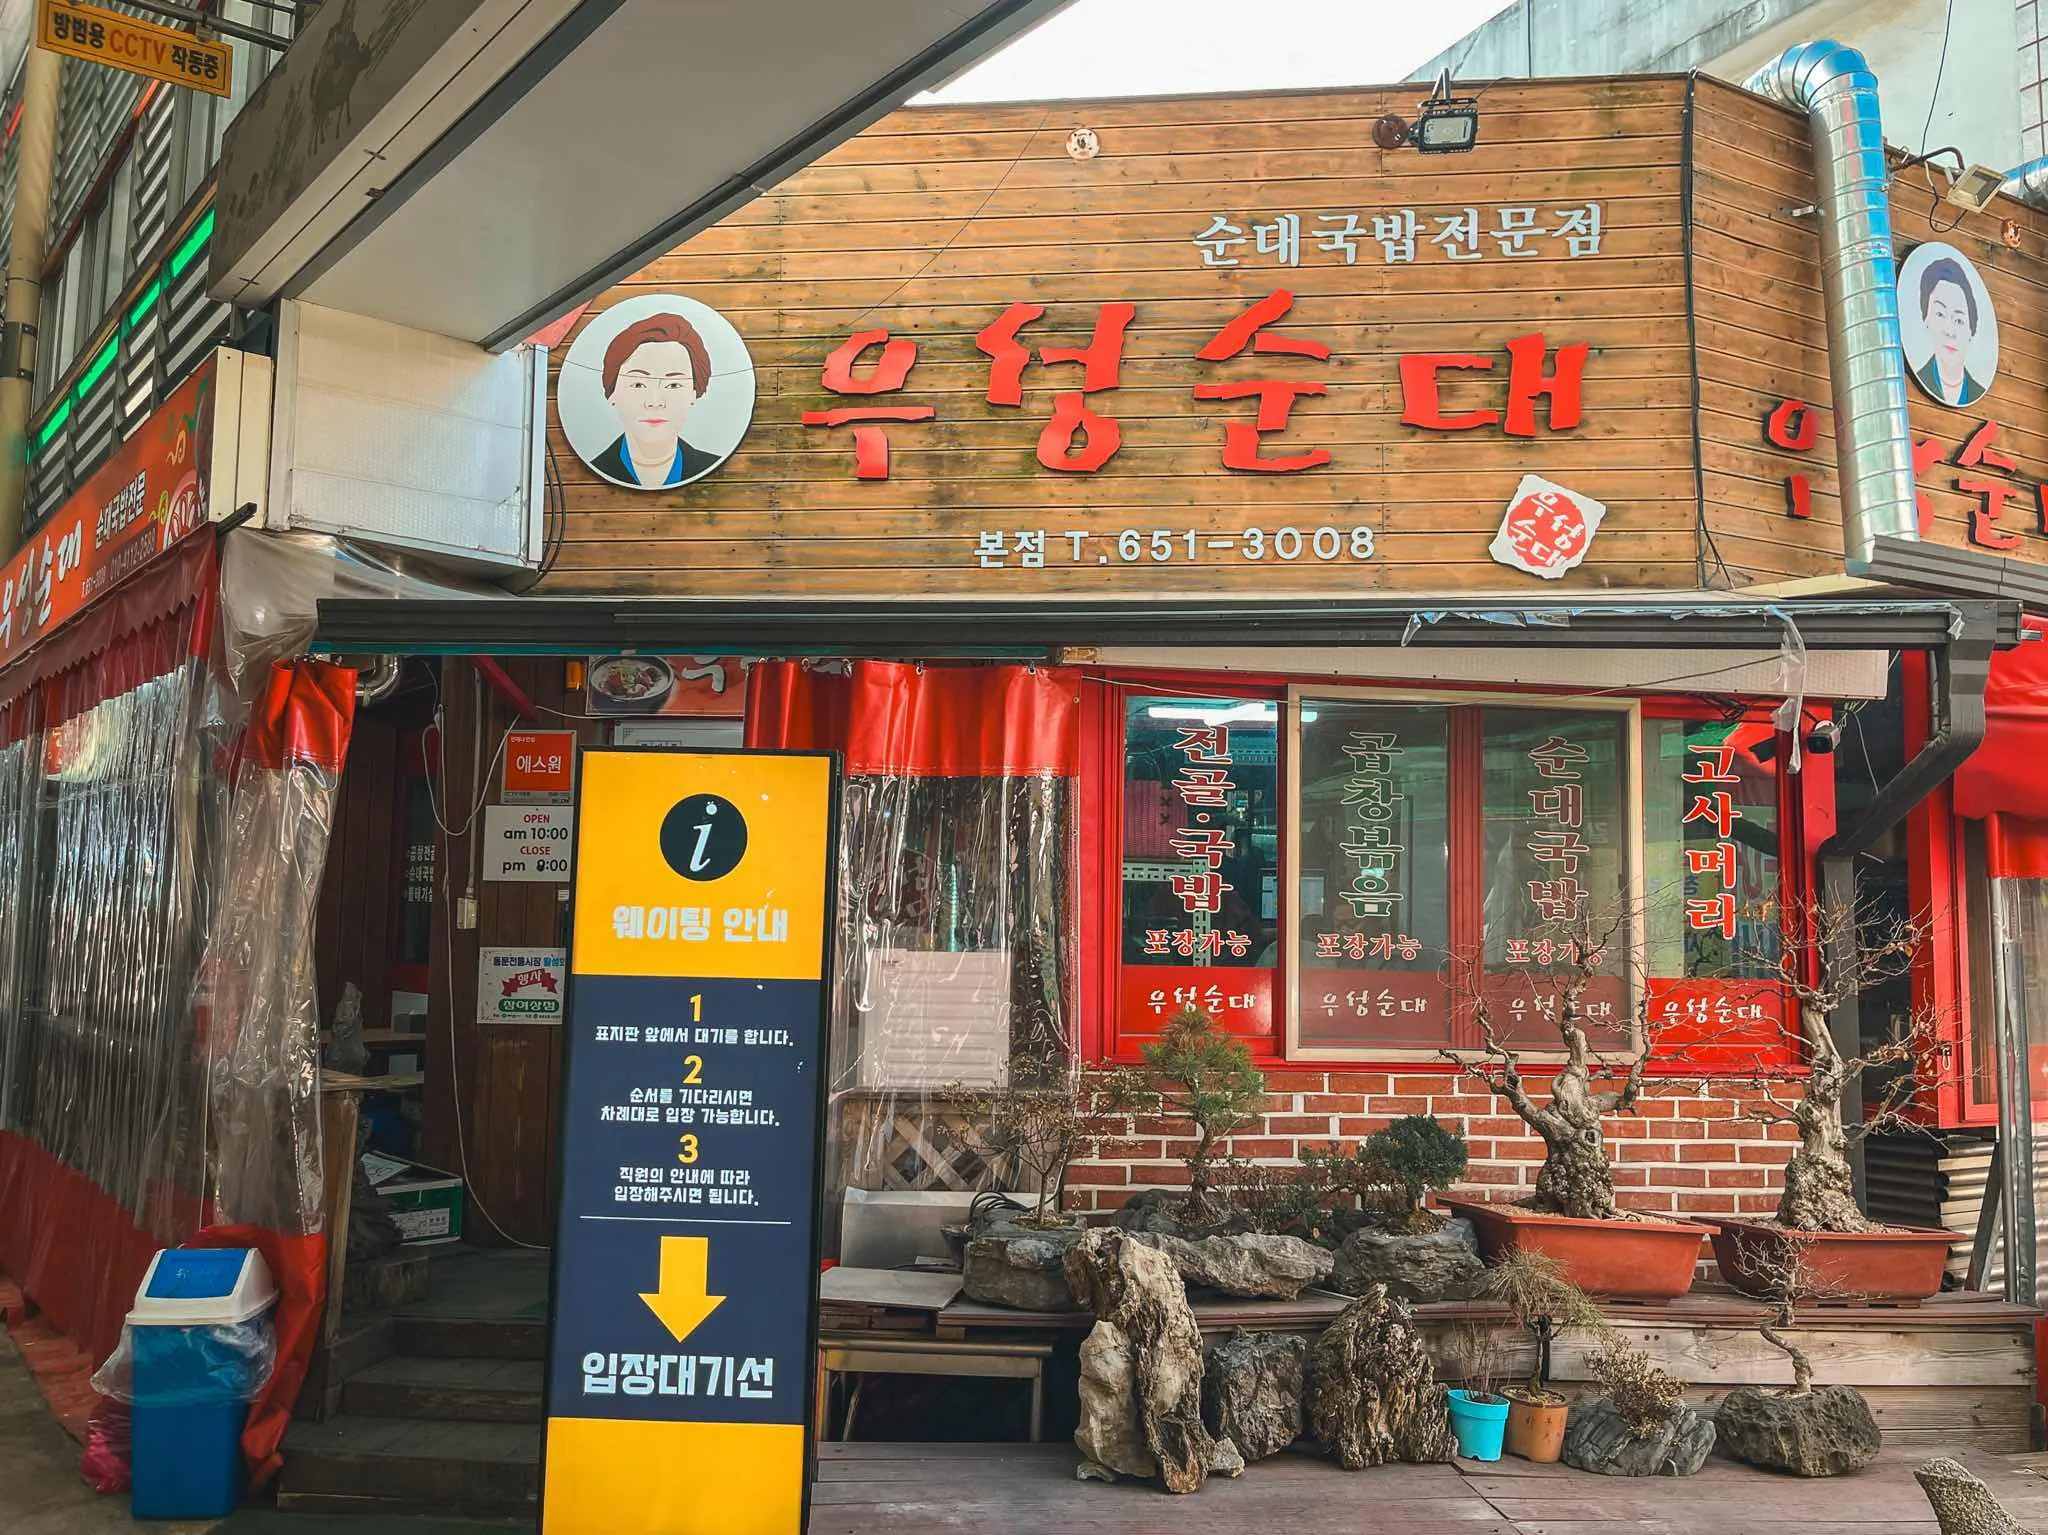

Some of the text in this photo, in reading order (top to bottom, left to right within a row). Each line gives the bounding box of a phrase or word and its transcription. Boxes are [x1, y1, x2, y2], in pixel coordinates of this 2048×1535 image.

[54, 12, 219, 80] 방범용 CCTV 작동중
[1193, 203, 1601, 267] 순대국밥전문점
[802, 289, 1590, 479] 우성순대
[1531, 492, 1585, 550] 우성
[974, 526, 1376, 568] 본점 T.651-3008
[1509, 519, 1570, 568] 순대
[516, 755, 562, 774] 에스원
[524, 814, 550, 823] OPEN
[1338, 730, 1405, 918] 곱창볶음
[1527, 736, 1590, 921] 순대국밥
[503, 828, 568, 840] am 10:00
[1681, 744, 1742, 940] 고사머리
[520, 846, 551, 855] CLOSE
[502, 862, 526, 874] pm
[613, 905, 788, 942] 웨이팅 안내
[1143, 928, 1252, 957] 포장가능
[1316, 932, 1422, 961] 포장가능
[518, 969, 542, 985] 행사
[503, 1000, 556, 1012] 참여상점
[689, 994, 702, 1022] 1
[1147, 984, 1257, 1014] 우성순대
[1320, 988, 1427, 1018] 우성순대
[1661, 996, 1762, 1024] 우성순대
[595, 1026, 794, 1047] 표지판 앞에서 대기를 합니다.
[683, 1055, 703, 1084] 2
[630, 1087, 753, 1106] 순서를 기다리시면
[600, 1106, 780, 1127] 차례대로 입장 가능합니다.
[678, 1133, 699, 1163] 3
[619, 1167, 751, 1186] 직원의 안내에 따라
[614, 1186, 759, 1207] 입장해주시면 됩니다.
[583, 1352, 774, 1399] 입장대기선
